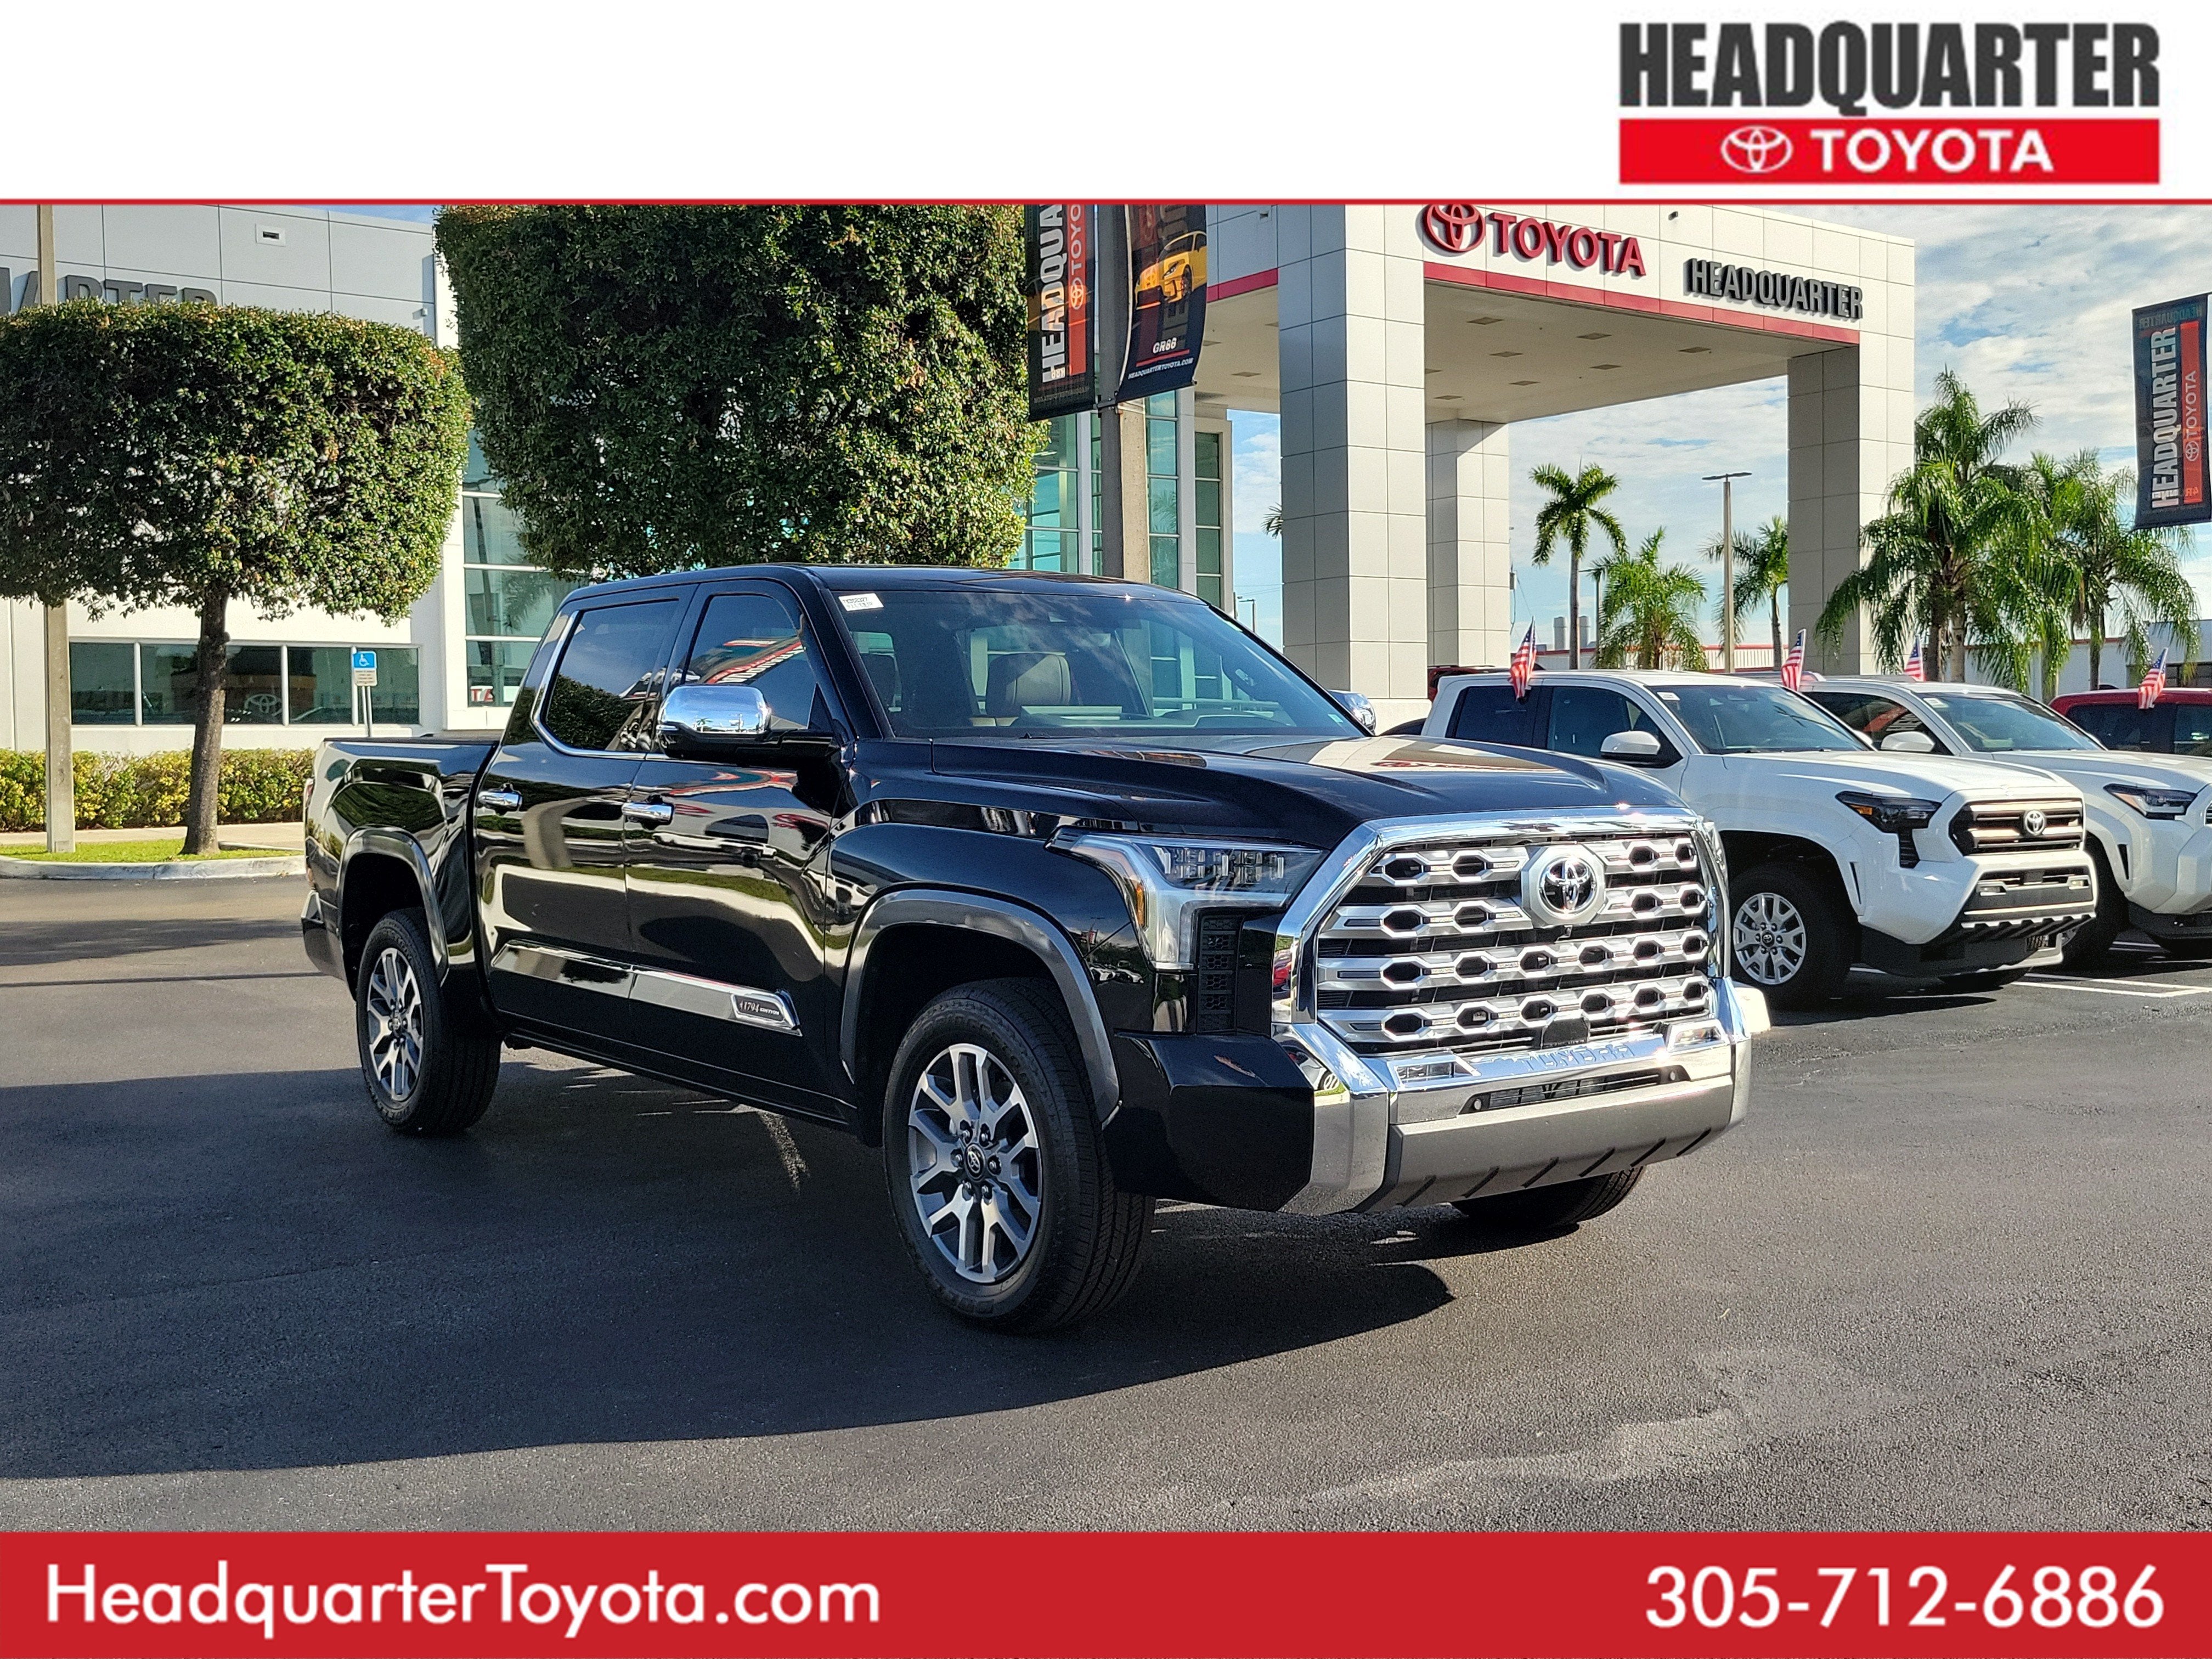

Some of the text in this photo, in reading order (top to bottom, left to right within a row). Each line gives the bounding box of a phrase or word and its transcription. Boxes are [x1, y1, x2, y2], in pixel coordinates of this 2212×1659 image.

[1488, 212, 1646, 276] TOYOTA
[1039, 204, 1067, 382] HEADQUA
[1689, 257, 1864, 319] HEADQUARTER
[2151, 327, 2181, 509] HEADQUARTER
[2185, 370, 2197, 437] TOYOTA
